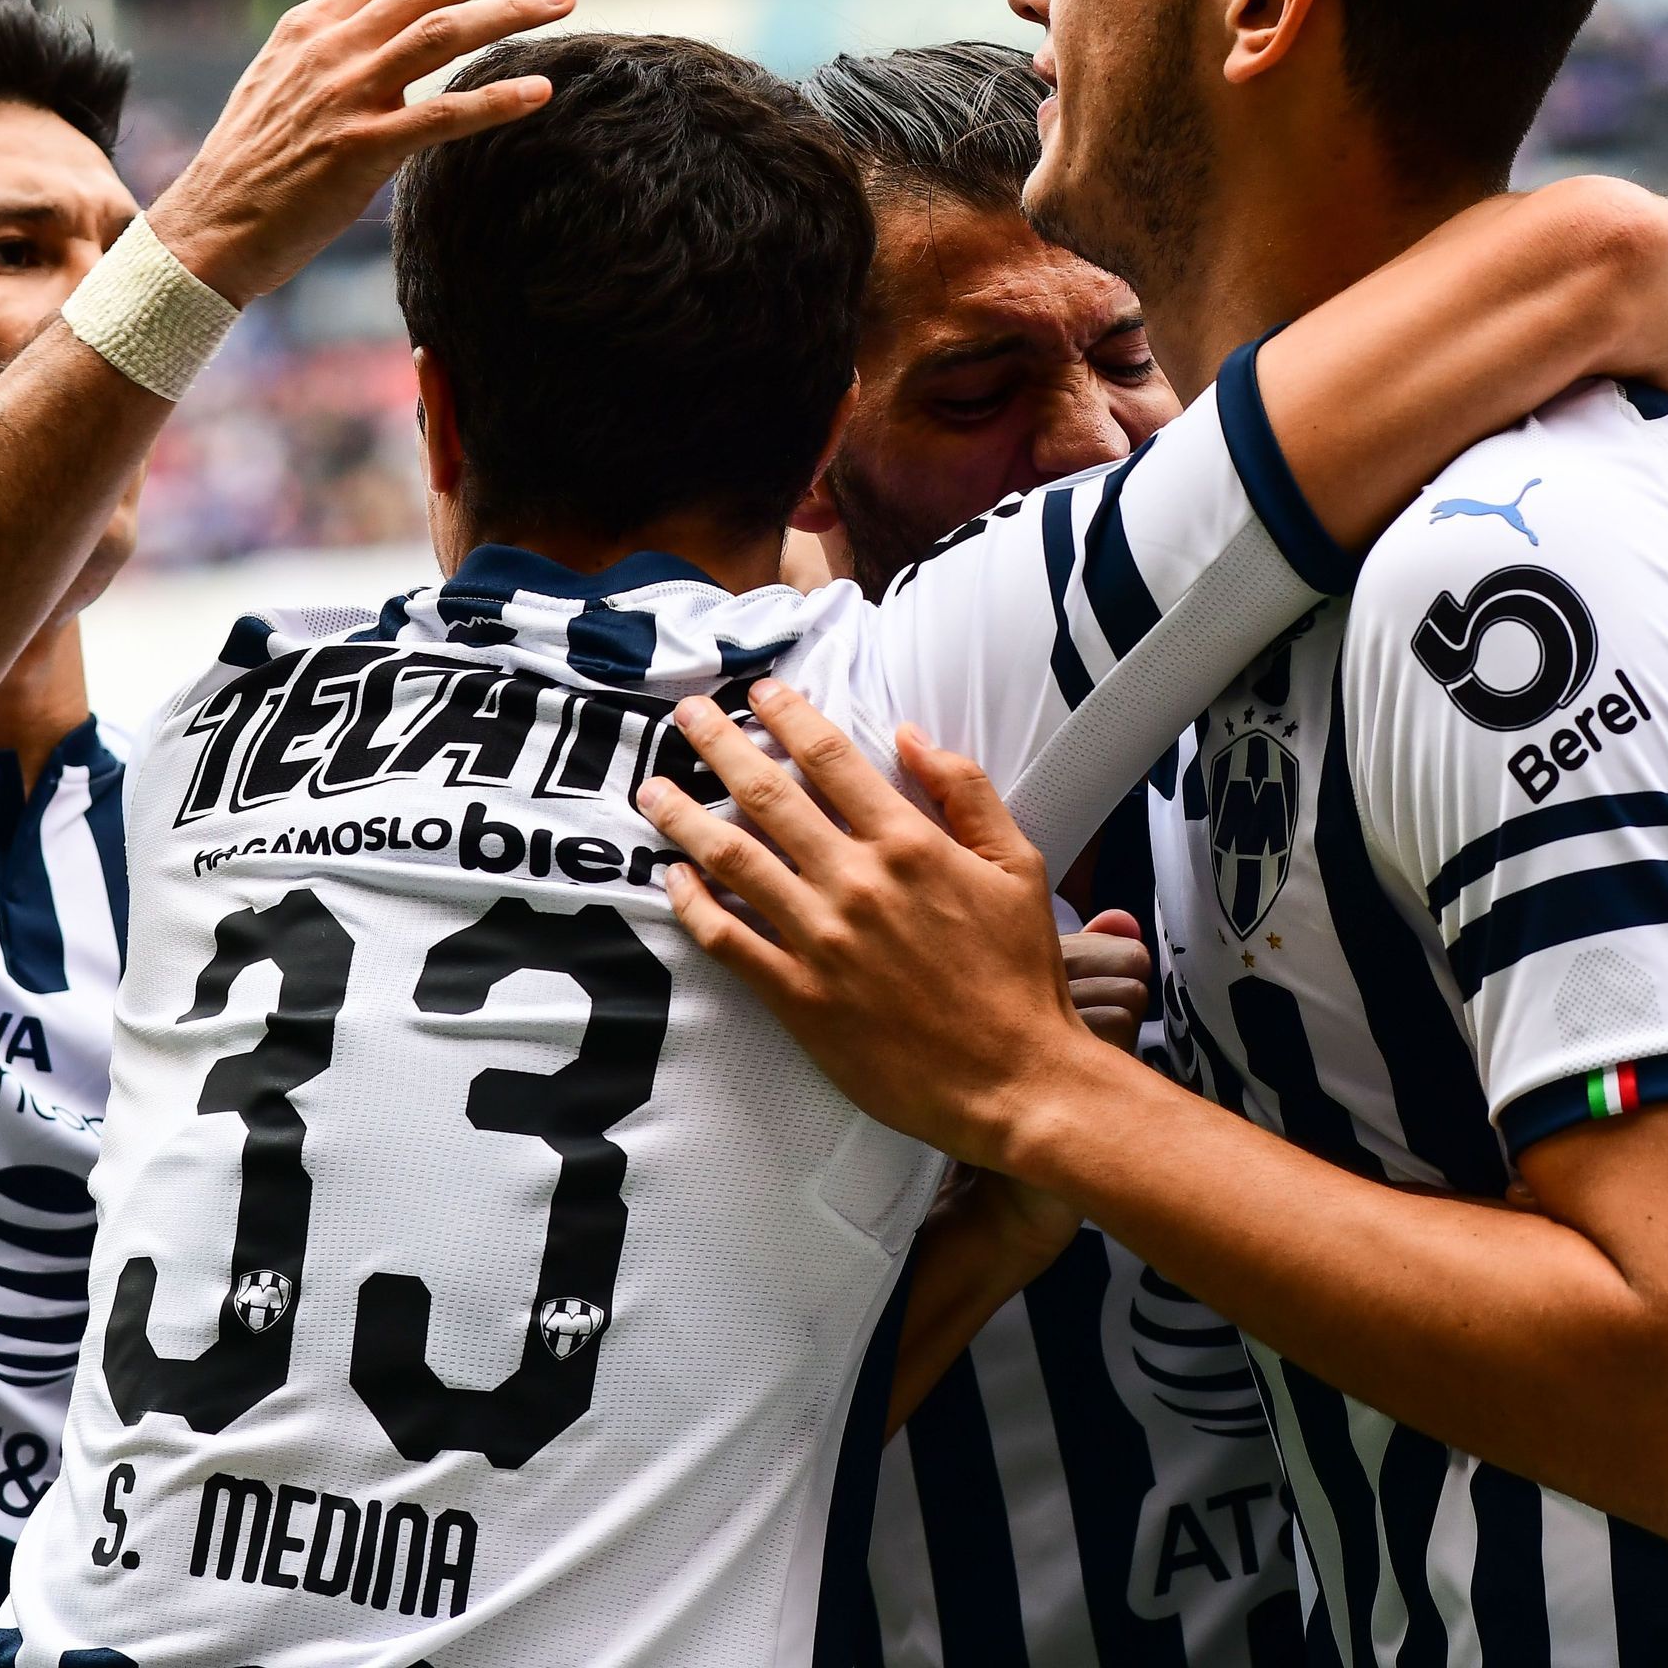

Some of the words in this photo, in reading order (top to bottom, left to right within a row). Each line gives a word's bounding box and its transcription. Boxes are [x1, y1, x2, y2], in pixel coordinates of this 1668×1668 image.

[1507, 669, 1652, 805] Berel
[103, 888, 672, 1470] 33
[92, 1463, 140, 1570] S.
[189, 1472, 479, 1619] MEDINA
